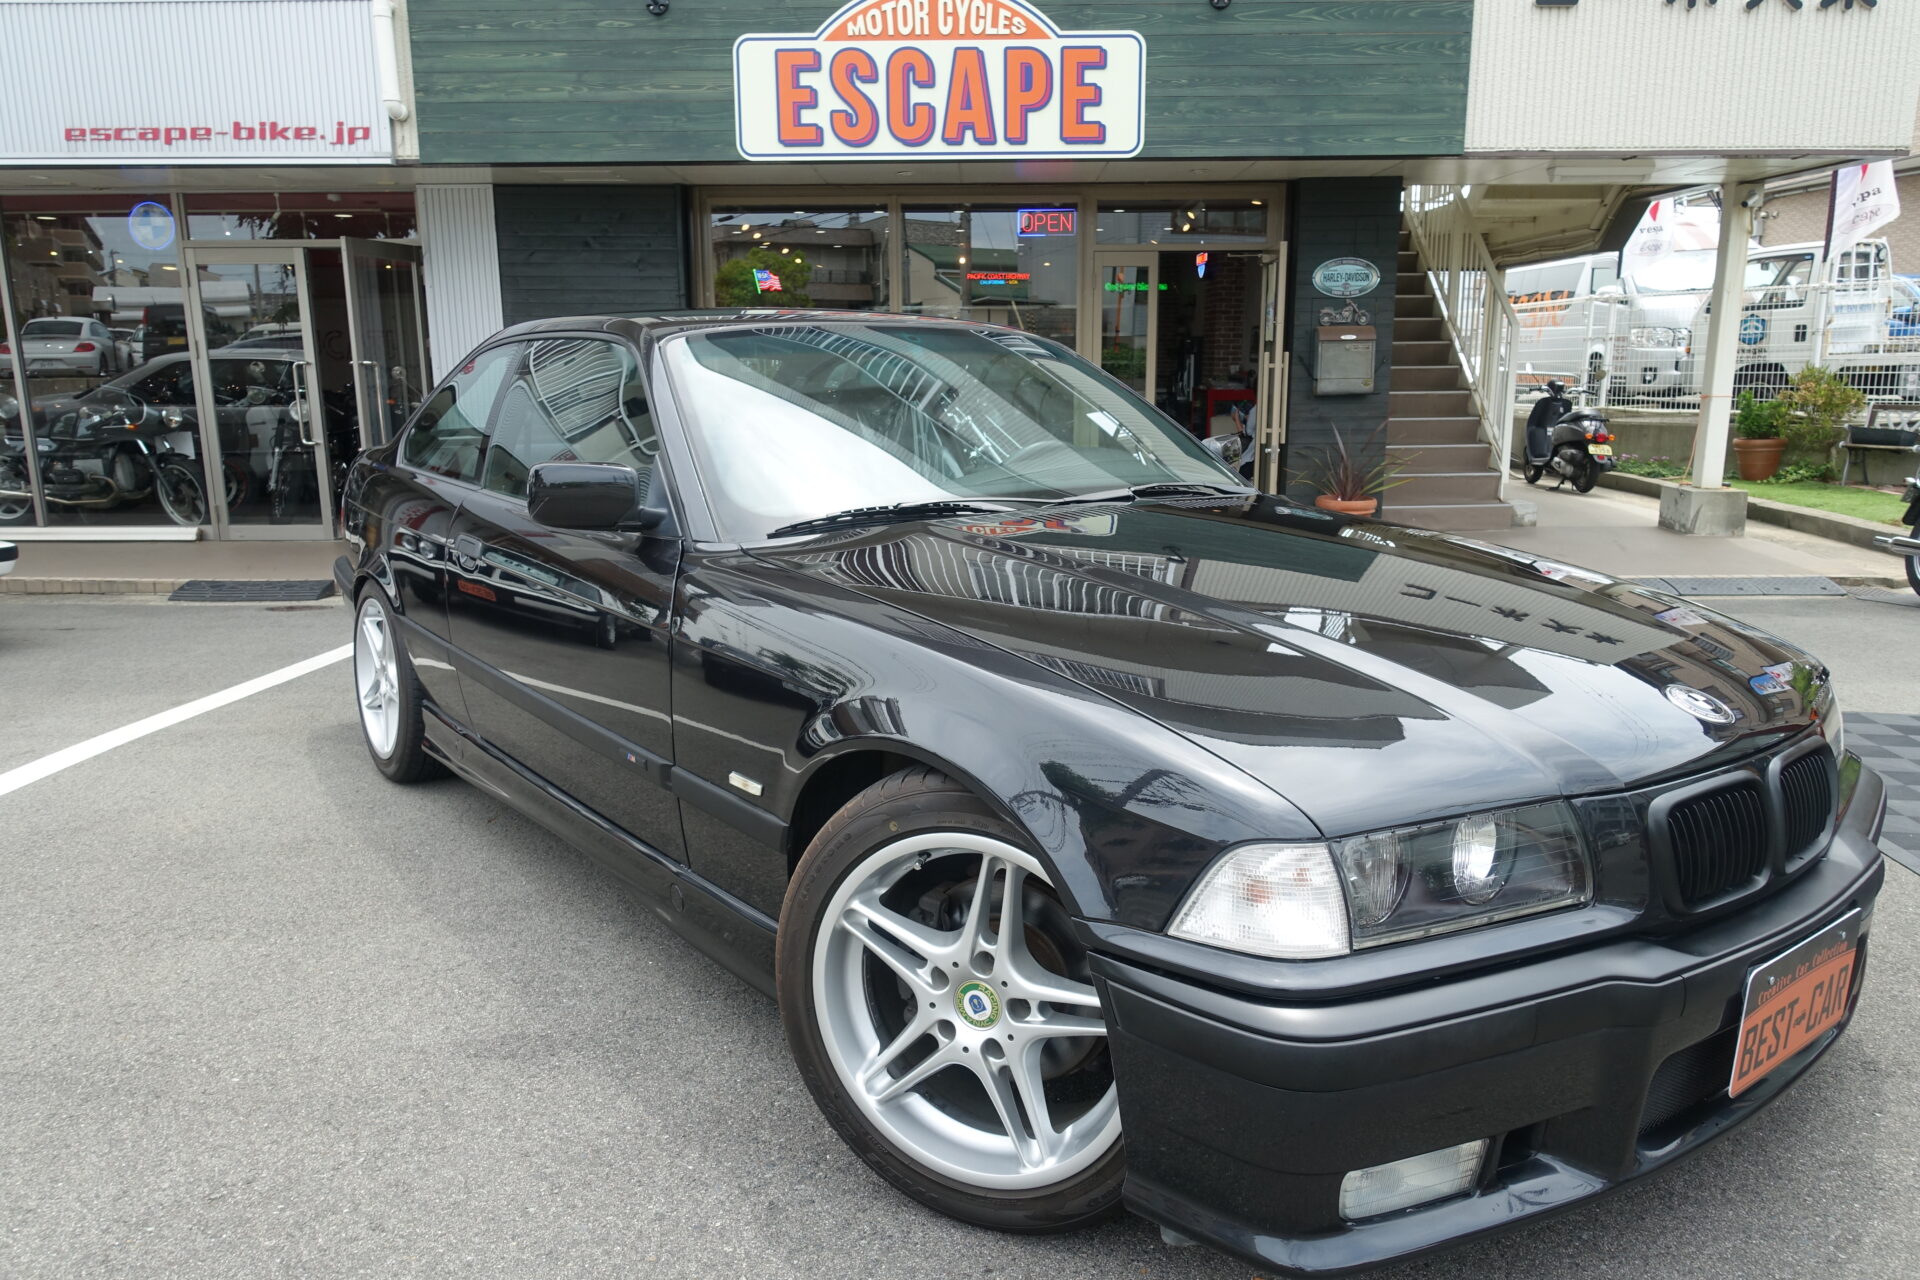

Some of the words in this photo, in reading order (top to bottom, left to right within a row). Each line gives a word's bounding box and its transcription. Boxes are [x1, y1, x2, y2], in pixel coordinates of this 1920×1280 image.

[846, 0, 930, 36] MOTOR
[937, 0, 1028, 36] CYCLES
[775, 45, 1107, 148] ESCAPE
[64, 121, 371, 146] escape-bike.jp
[1021, 212, 1073, 232] OPEN
[1322, 271, 1371, 283] HARLEY-DAVIDSON
[1758, 973, 1793, 1006] Creative
[1796, 962, 1810, 978] Car
[1812, 940, 1849, 968] Collection
[1737, 963, 1850, 1081] BEST-CAR
